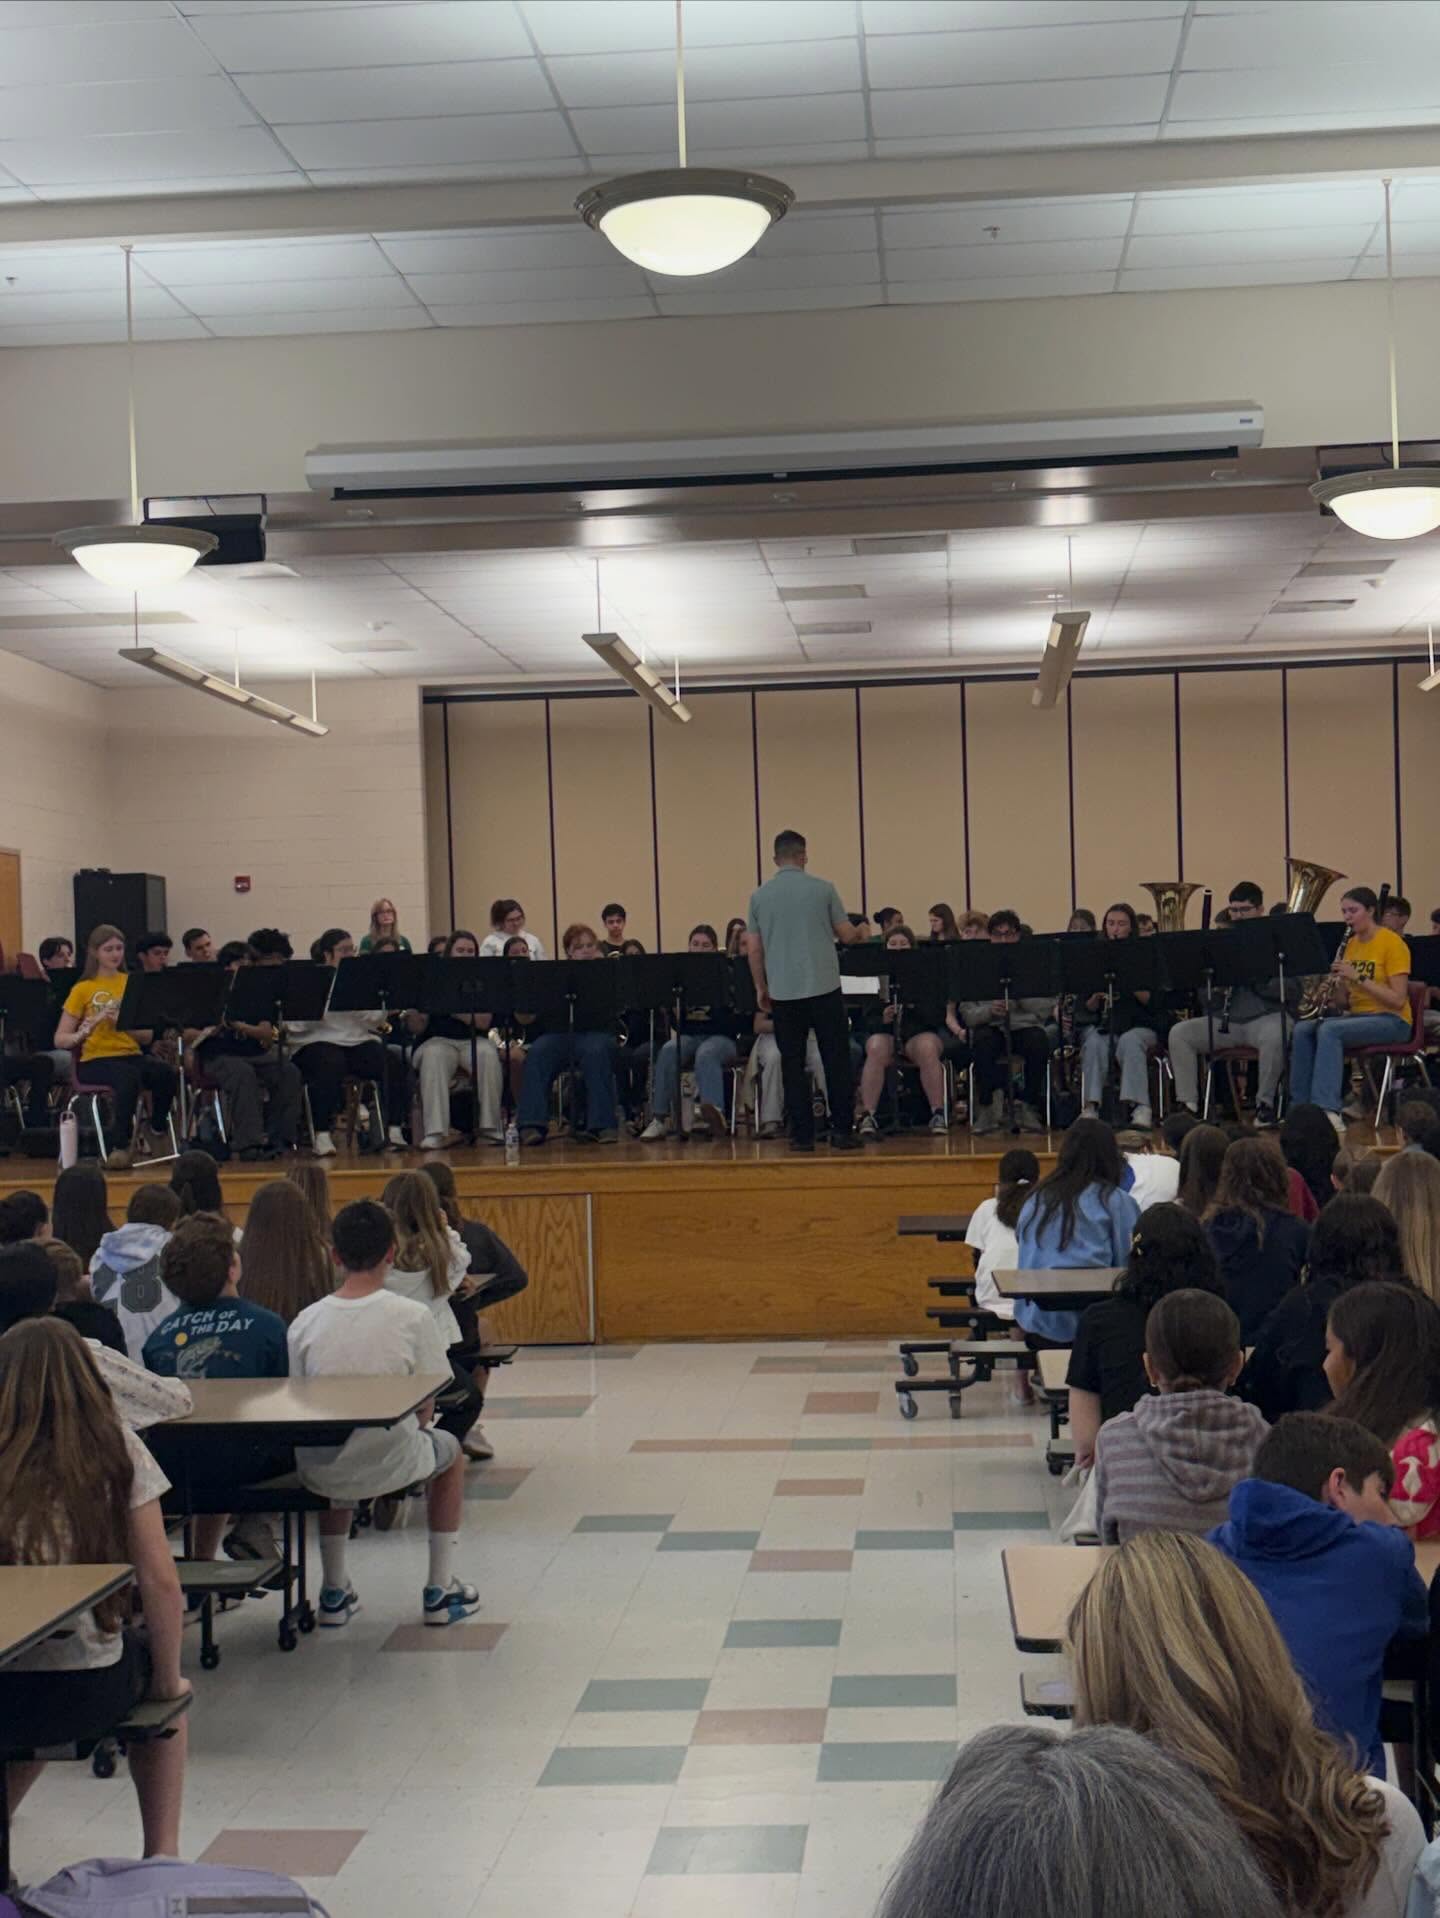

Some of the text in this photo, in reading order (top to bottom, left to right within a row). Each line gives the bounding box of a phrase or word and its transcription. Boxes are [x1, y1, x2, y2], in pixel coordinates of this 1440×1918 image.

[161, 1310, 237, 1335] CATCH OF
[191, 1318, 254, 1335] THE DAY
